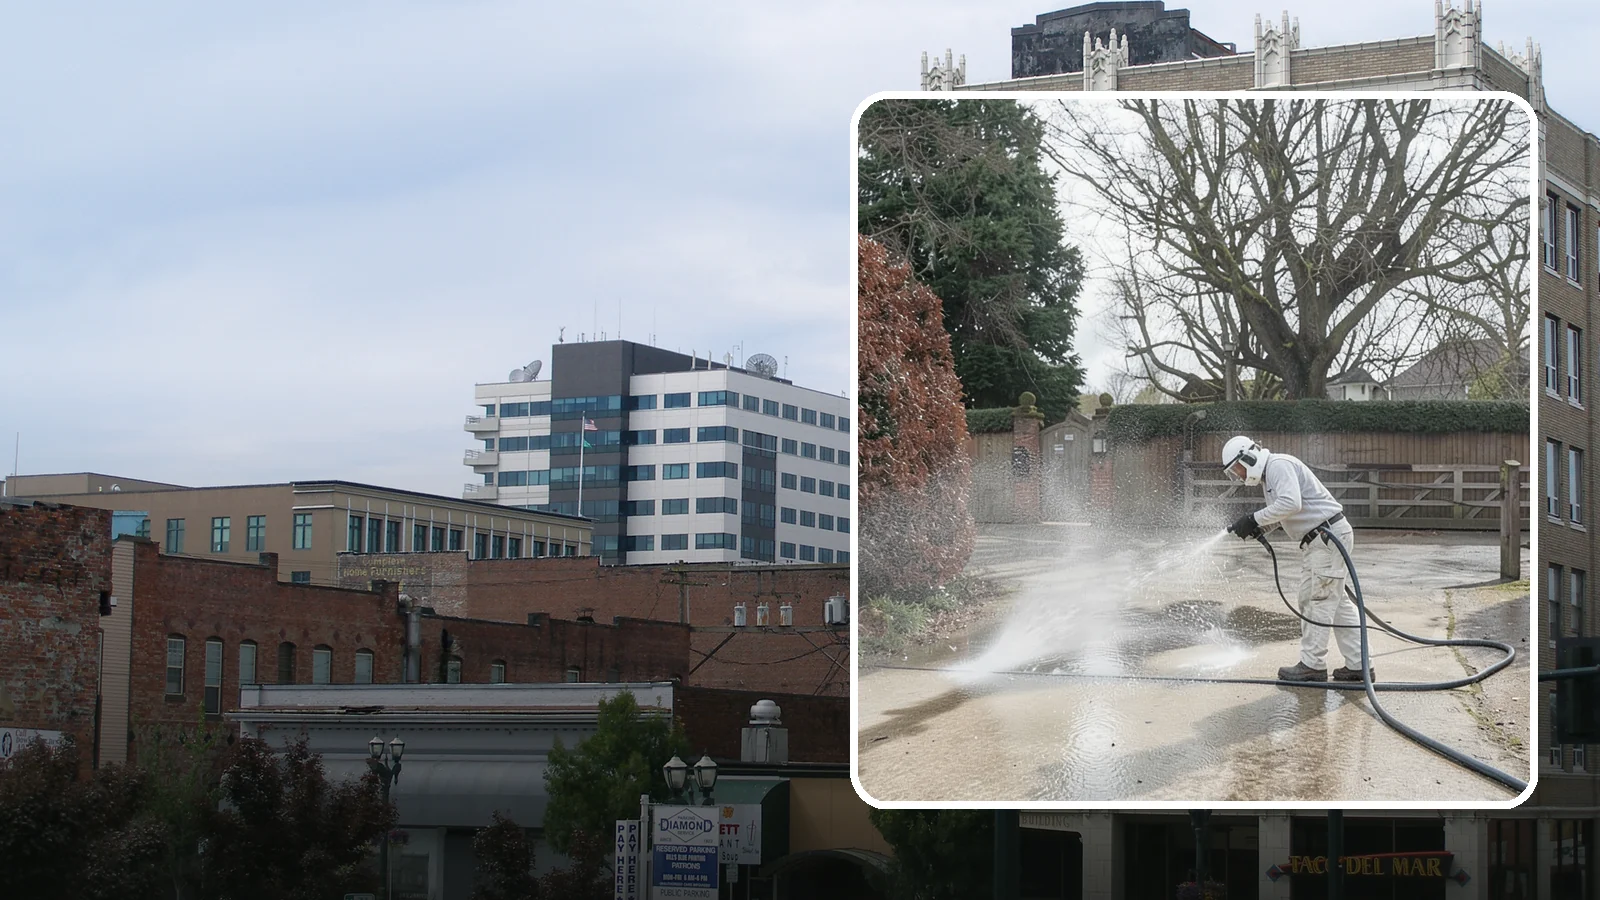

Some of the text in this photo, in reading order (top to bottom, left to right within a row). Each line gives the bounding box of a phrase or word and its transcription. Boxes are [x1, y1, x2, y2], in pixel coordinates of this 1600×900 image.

[660, 818, 713, 833] DIAMOND
[1022, 815, 1070, 827] BUILDING
[656, 845, 716, 854] RESERVED PARKING
[616, 825, 625, 894] PAY HERE
[627, 824, 637, 893] PAY HERE
[721, 851, 739, 862] Soup
[671, 862, 701, 870] PATRONS
[1290, 855, 1442, 877] TAC DEL MAR
[660, 889, 710, 898] PUBLIC PARKING
